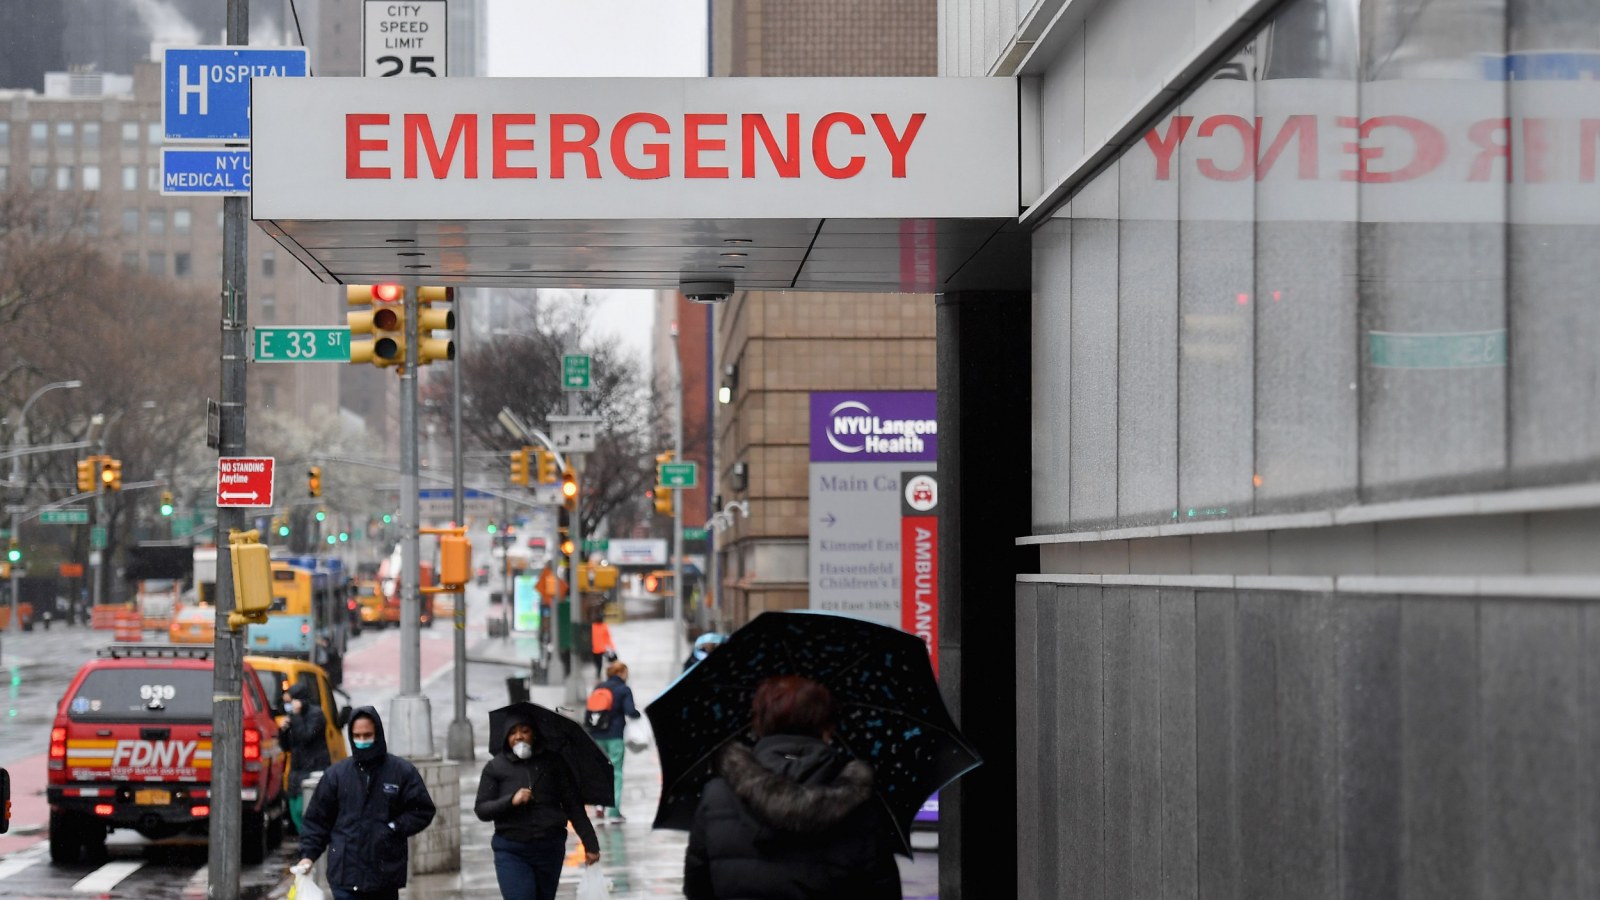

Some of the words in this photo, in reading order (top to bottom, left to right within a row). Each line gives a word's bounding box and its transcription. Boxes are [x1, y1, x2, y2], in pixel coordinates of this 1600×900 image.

[387, 5, 421, 17] CITY
[380, 21, 429, 33] SPEED
[385, 37, 424, 49] LIMIT
[376, 55, 437, 77] 25
[345, 112, 926, 180] EMERGENCY
[216, 156, 251, 170] NYU
[166, 173, 235, 187] MEDICAL
[260, 331, 275, 358] E
[286, 331, 316, 358] 33
[327, 332, 342, 346] ST
[865, 434, 924, 453] Health
[221, 462, 232, 473] NO
[232, 462, 265, 473] STANDING
[221, 473, 249, 486] Anytime
[820, 474, 869, 492] Main
[914, 526, 932, 657] AMBULANC
[140, 684, 176, 700] 939
[112, 739, 198, 769] FDNY
